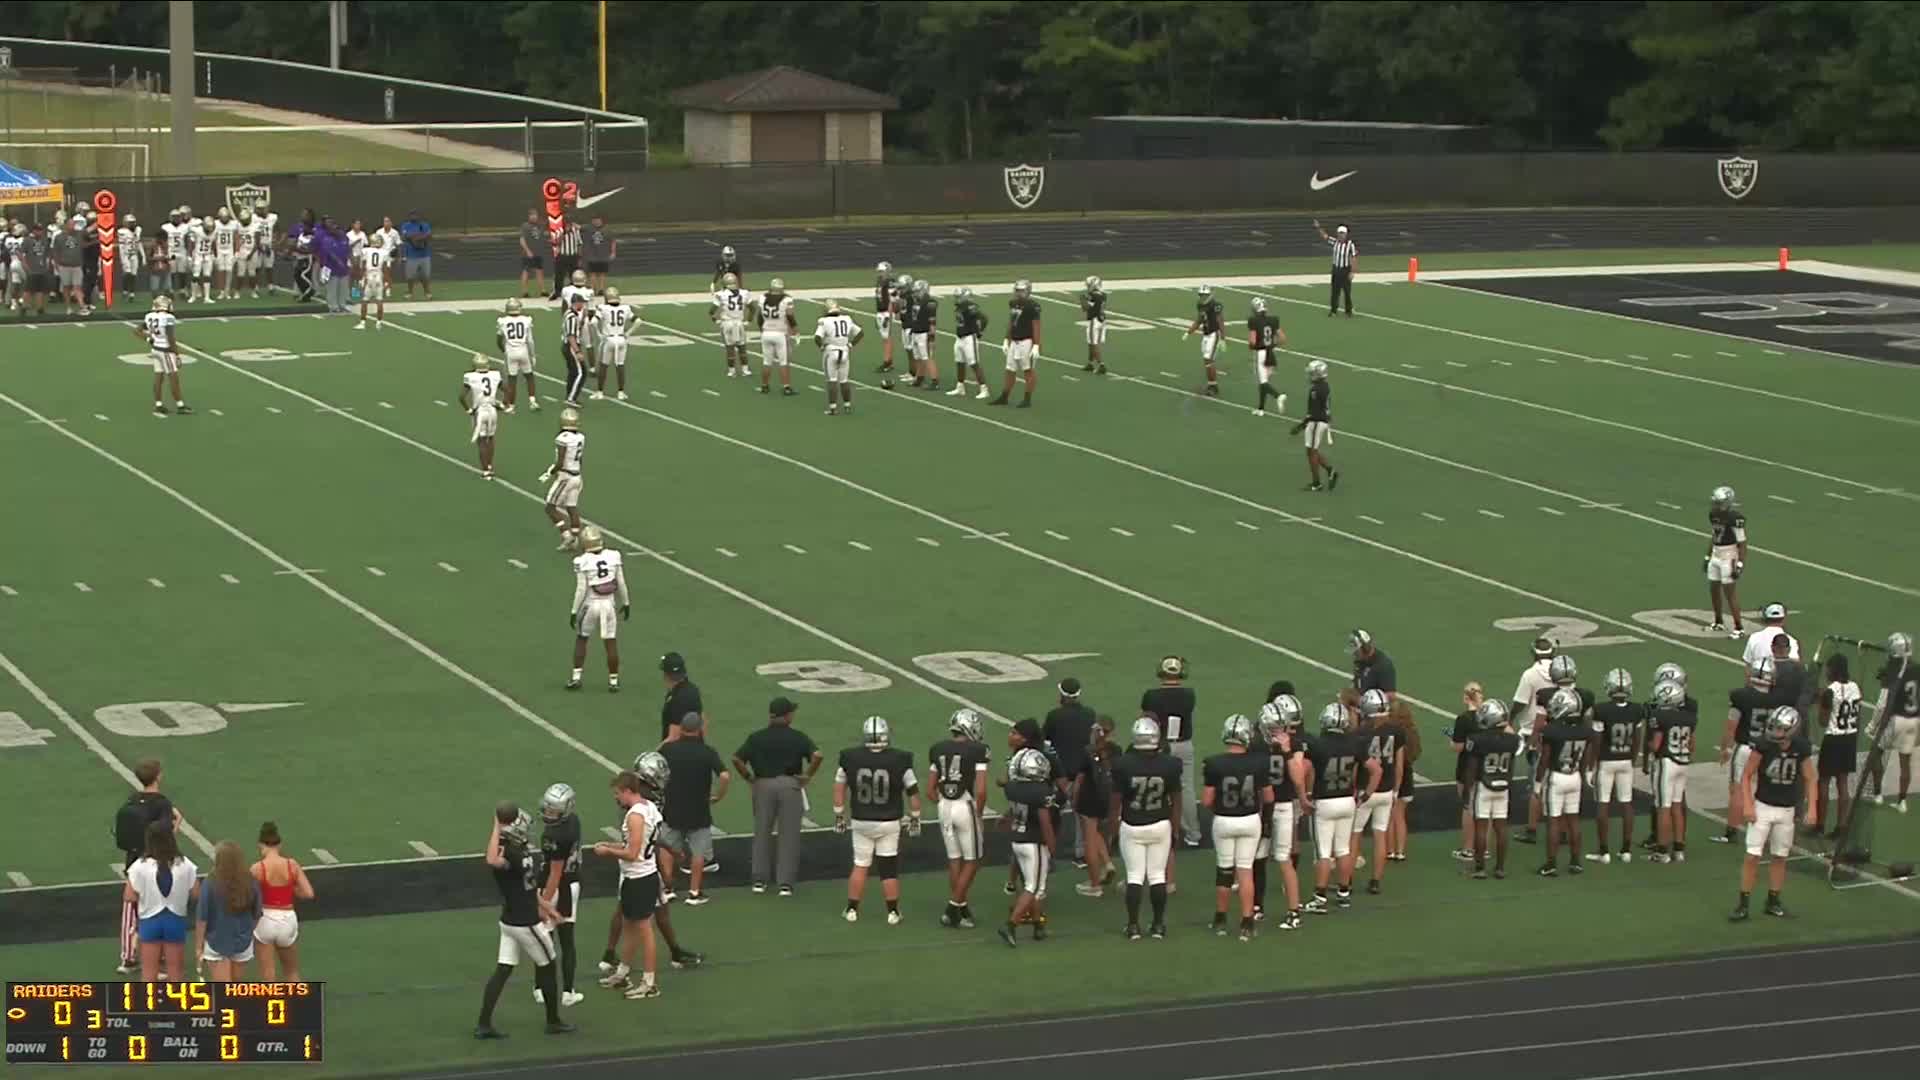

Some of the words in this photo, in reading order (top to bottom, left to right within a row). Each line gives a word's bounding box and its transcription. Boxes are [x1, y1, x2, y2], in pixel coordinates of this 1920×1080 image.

[371, 252, 380, 268] 0
[506, 321, 525, 340] 20
[609, 309, 625, 327] 16
[833, 319, 848, 338] 10
[481, 377, 492, 396] 3
[596, 560, 610, 579] 6
[755, 651, 1048, 693] 30
[1368, 734, 1395, 765] 44
[937, 754, 963, 783] 14
[1324, 755, 1355, 791] 45
[1765, 755, 1797, 785] 40
[856, 767, 890, 805] 60
[1131, 775, 1165, 811] 72
[1221, 775, 1255, 808] 64
